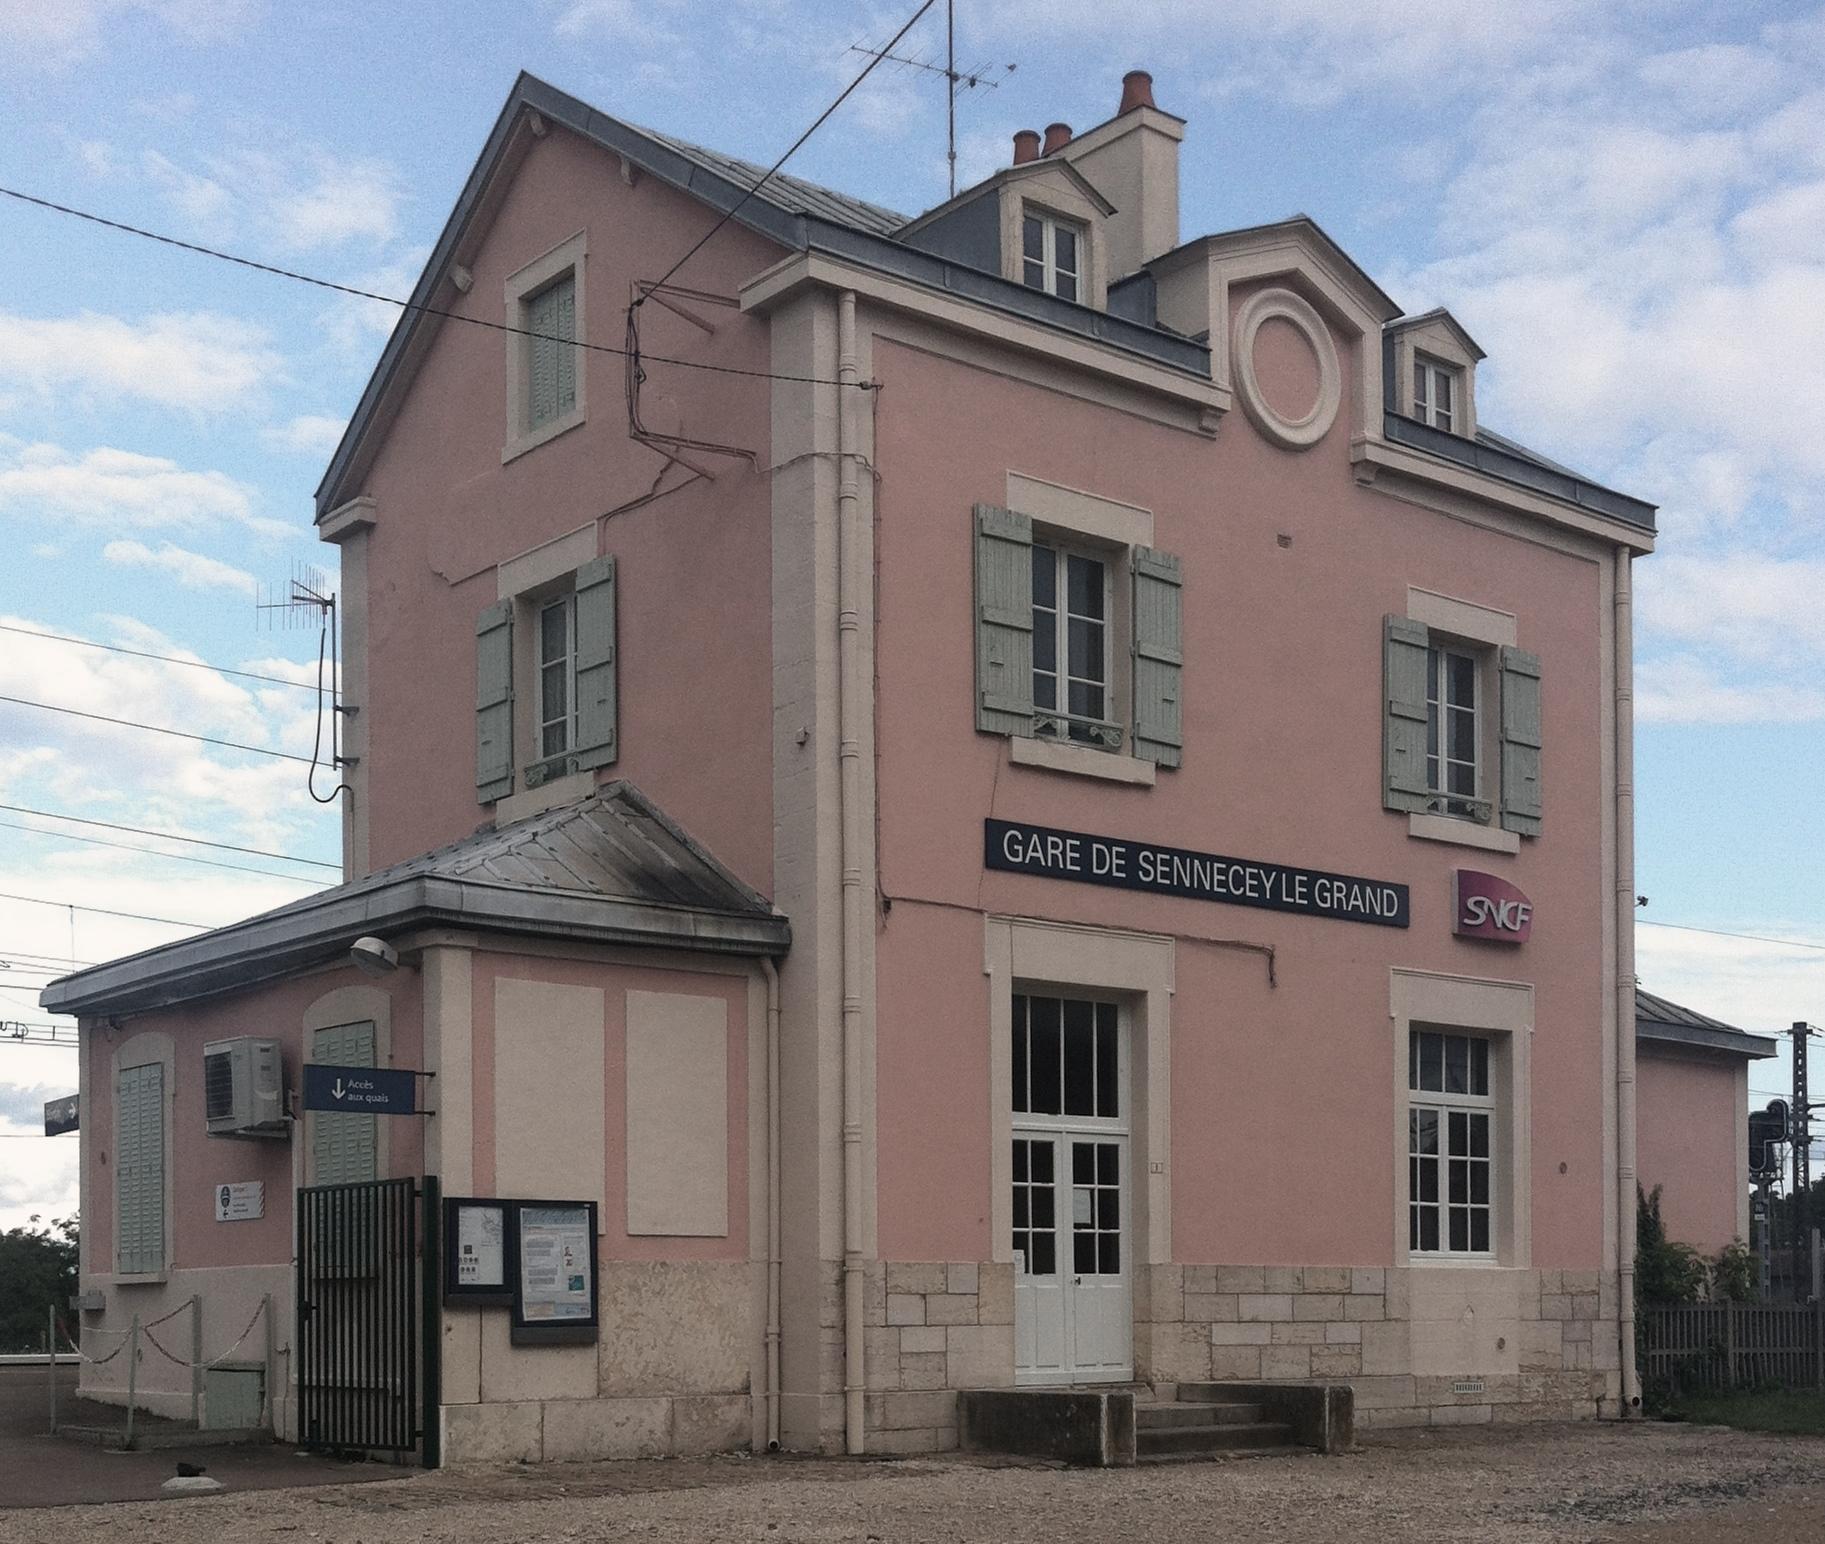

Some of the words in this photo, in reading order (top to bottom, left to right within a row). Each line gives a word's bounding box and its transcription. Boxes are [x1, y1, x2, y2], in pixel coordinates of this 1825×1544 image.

[1003, 829, 1081, 871] GARE
[1092, 843, 1126, 878] DE
[1138, 850, 1276, 900] SENNECEY
[1281, 870, 1308, 905] LE
[1314, 878, 1399, 918] GRAND
[1463, 896, 1532, 931] SNCF
[347, 1079, 374, 1090] Accès
[347, 1093, 363, 1102] aux
[365, 1093, 389, 1104] quais
